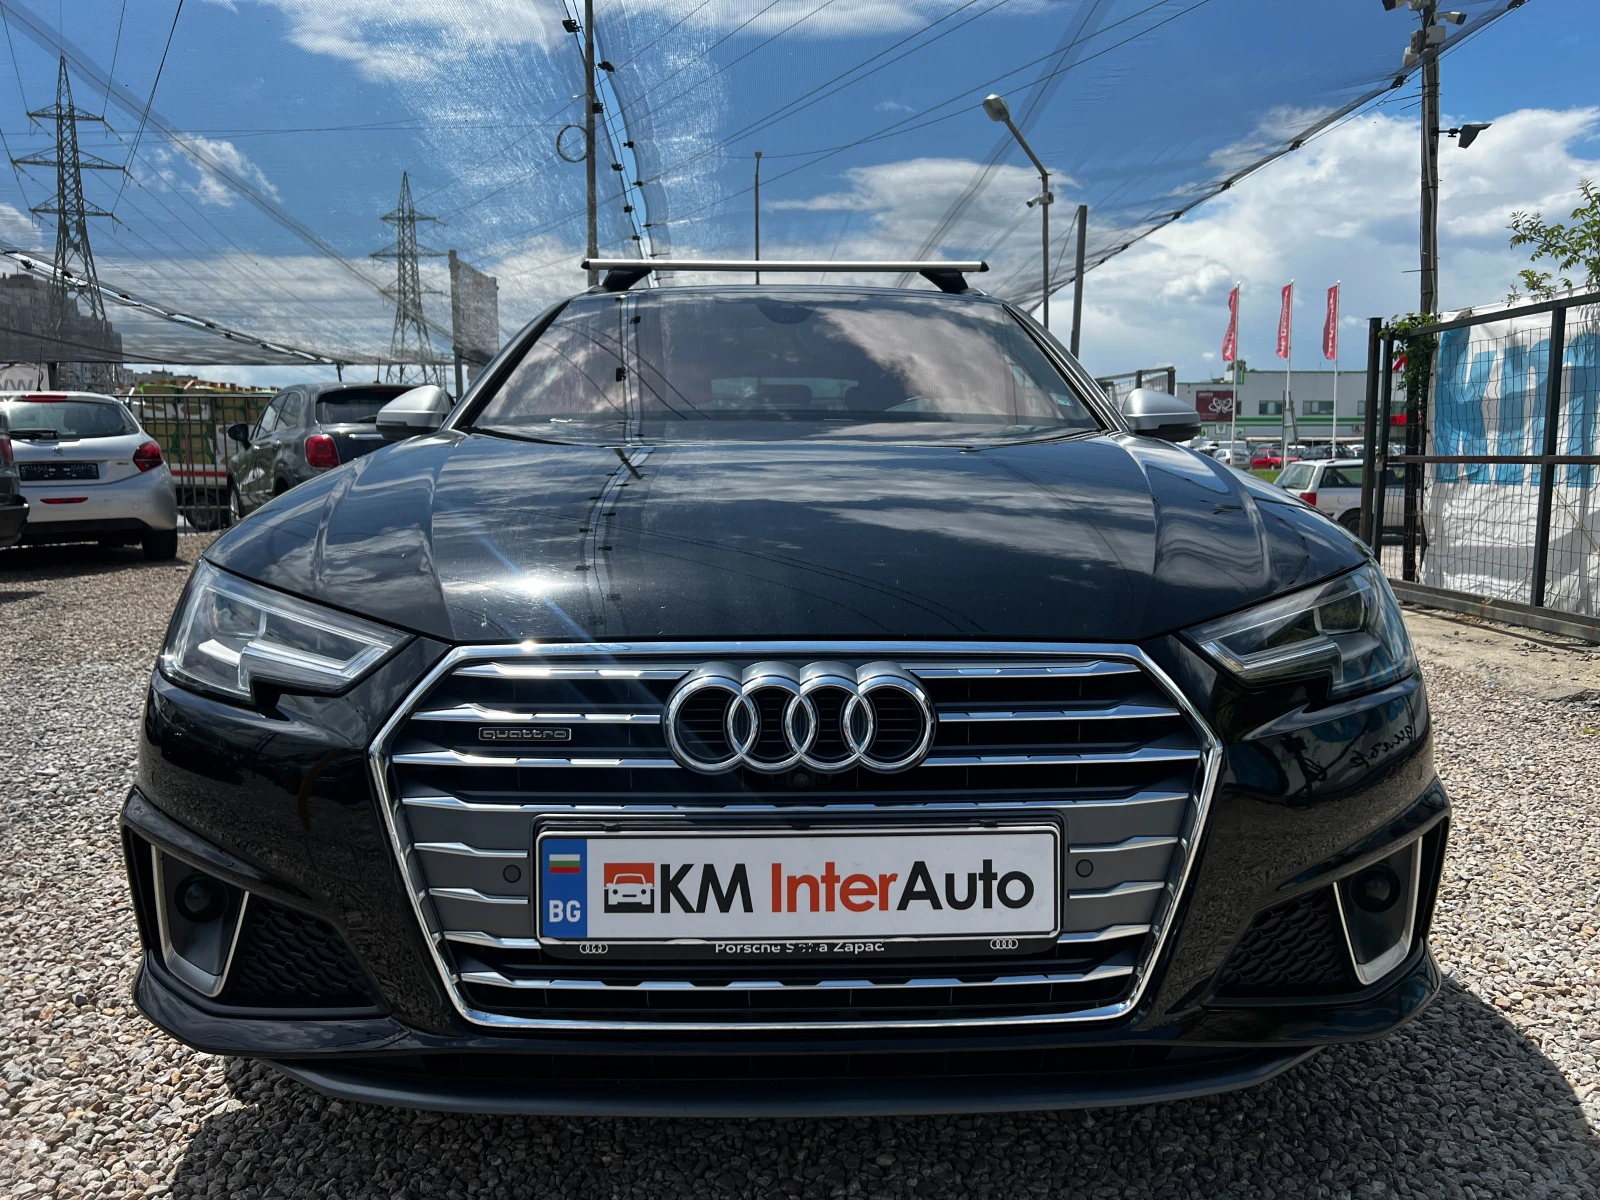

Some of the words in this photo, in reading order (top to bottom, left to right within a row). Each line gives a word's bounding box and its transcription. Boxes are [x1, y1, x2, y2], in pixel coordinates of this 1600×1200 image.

[482, 729, 567, 739] quattro
[660, 863, 754, 914] KM
[771, 858, 1035, 913] InterAuto
[549, 900, 581, 922] BG
[715, 942, 781, 954] Porsche
